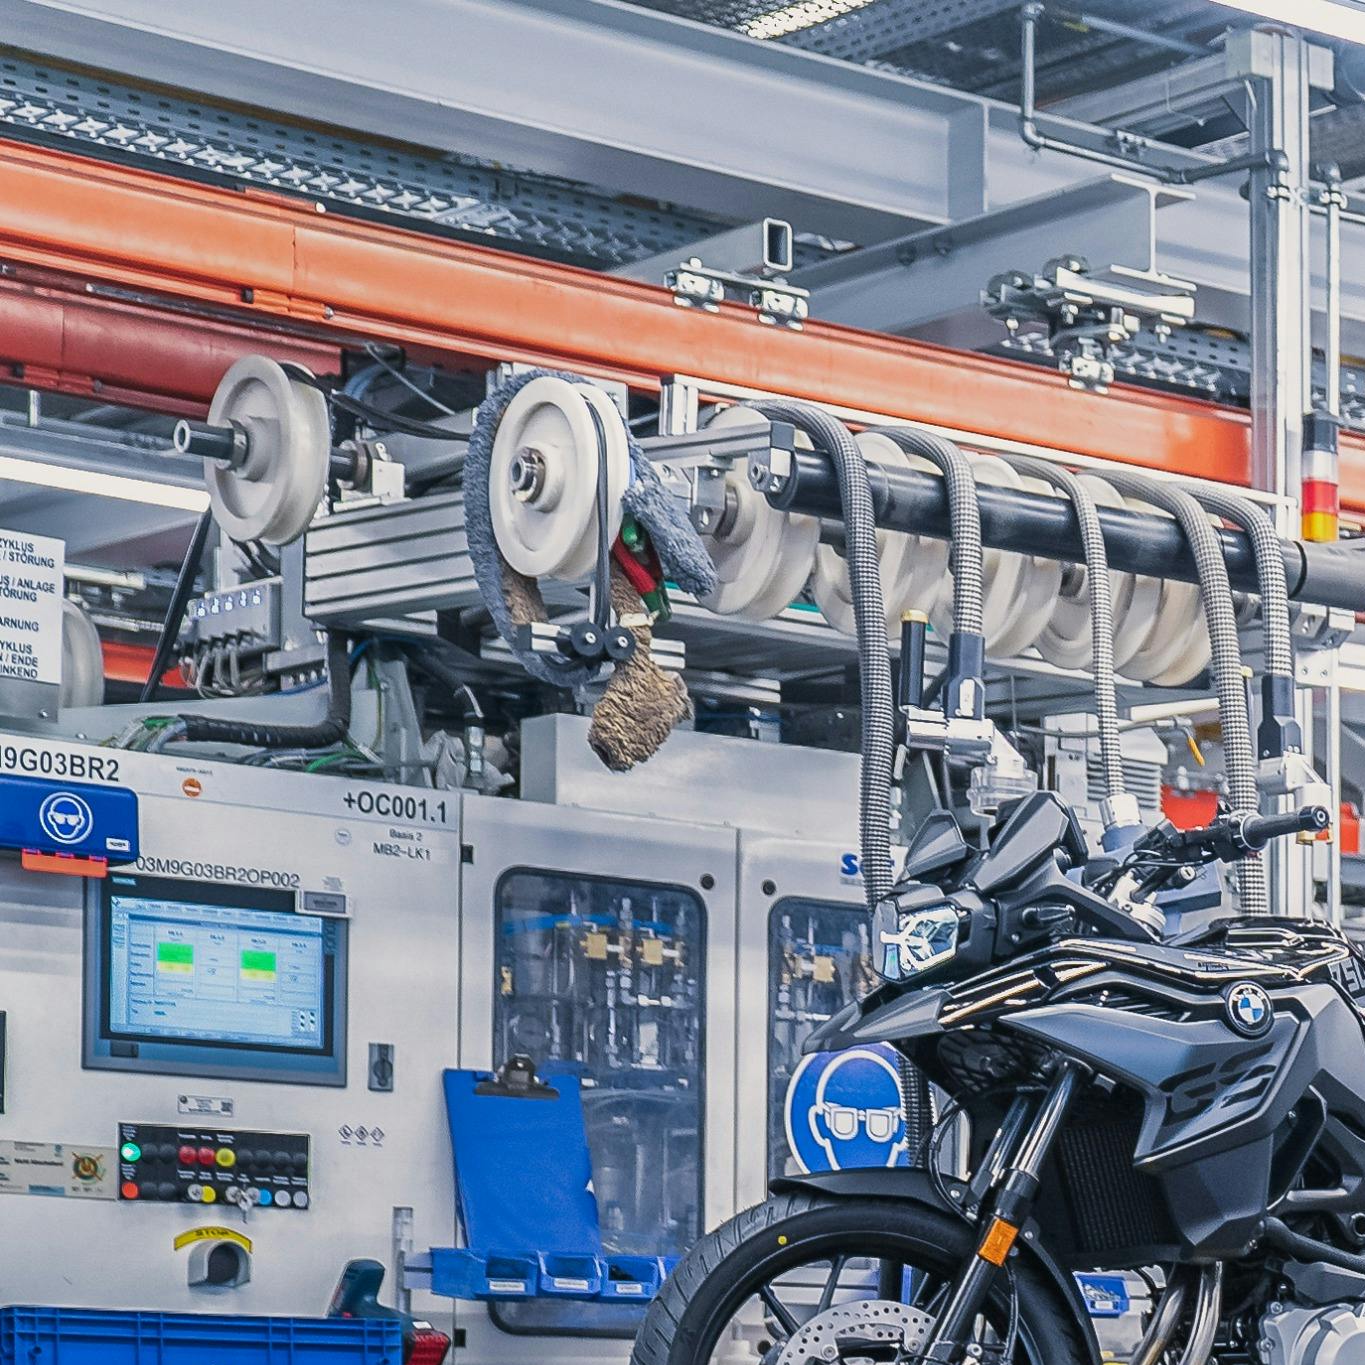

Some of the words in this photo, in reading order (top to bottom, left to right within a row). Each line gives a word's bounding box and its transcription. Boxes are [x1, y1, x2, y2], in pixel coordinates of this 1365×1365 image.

[0, 537, 34, 553] YKLUS
[17, 577, 55, 594] ANLAGE
[11, 653, 38, 668] ENDE
[0, 744, 119, 782] 9G03BR2
